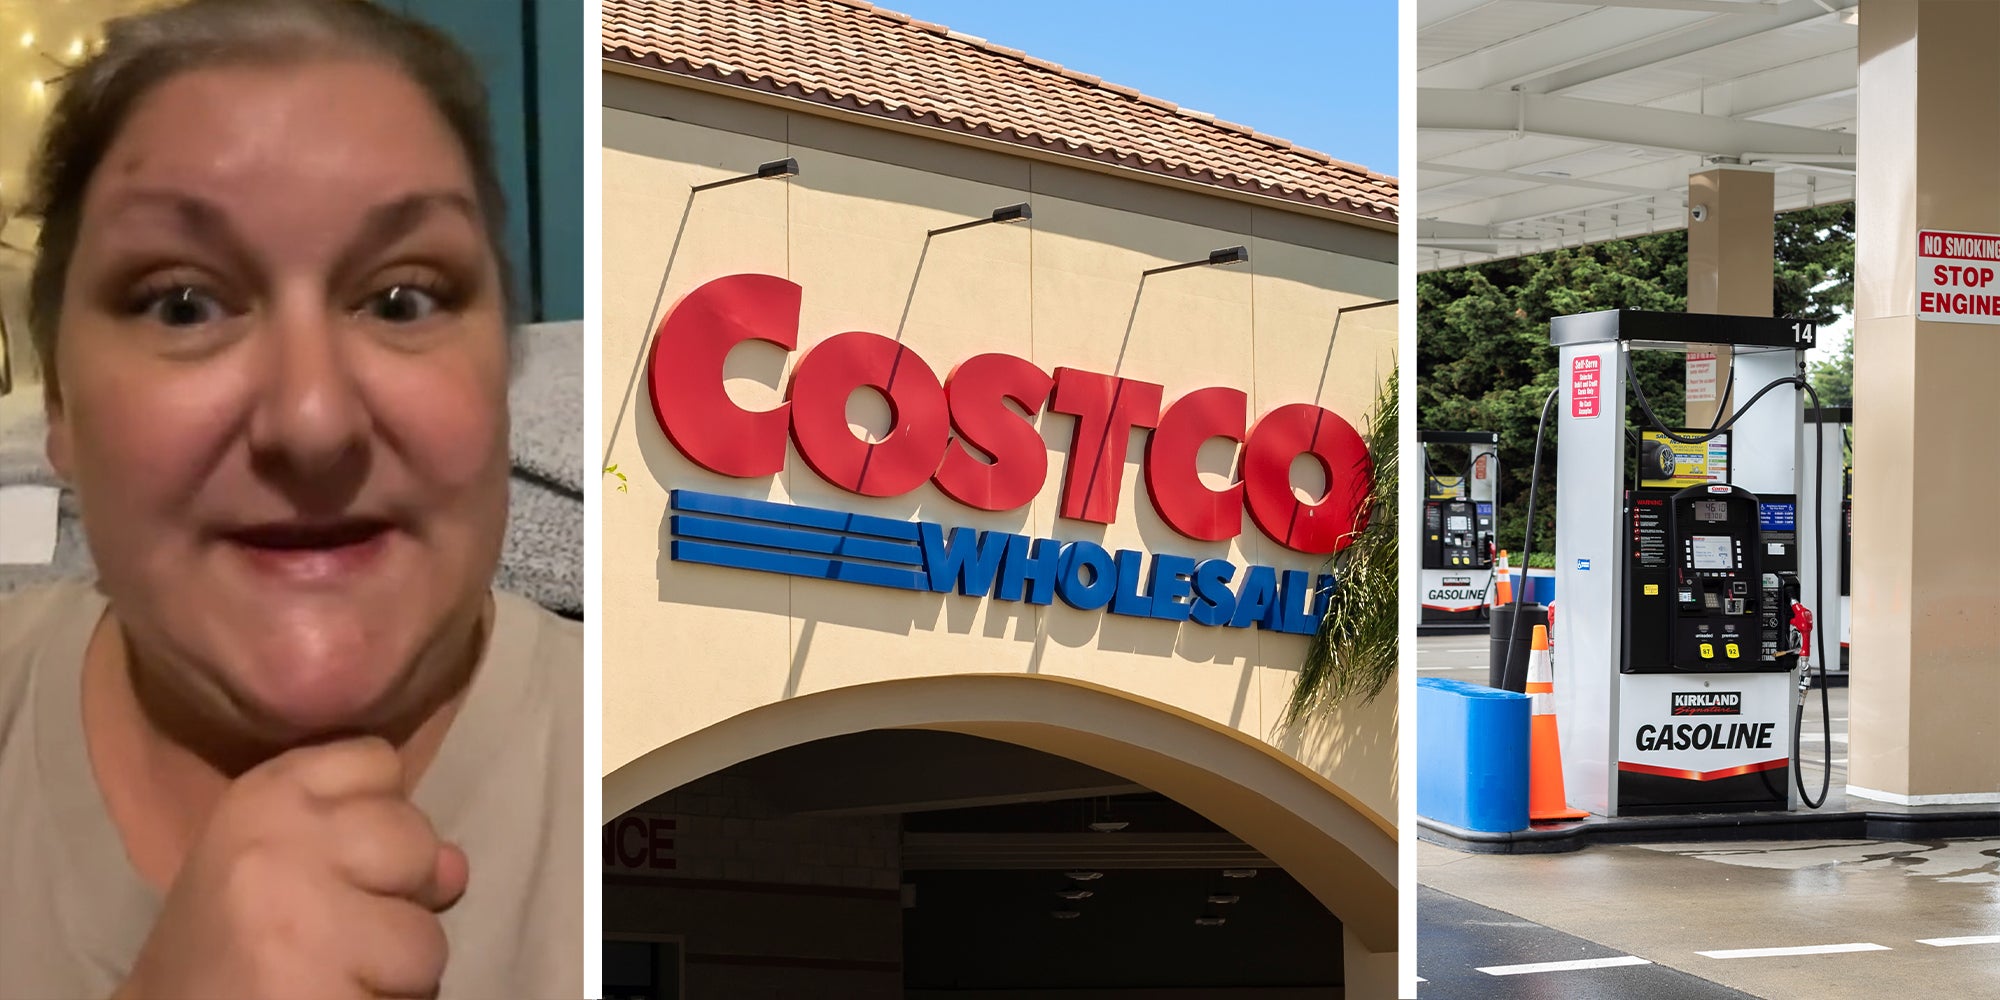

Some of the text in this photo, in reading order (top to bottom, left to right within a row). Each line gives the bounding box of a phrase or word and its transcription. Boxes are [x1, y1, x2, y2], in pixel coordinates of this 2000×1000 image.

[1924, 235, 1943, 256] NO
[1934, 264, 1994, 288] STOP
[1920, 291, 2000, 316] ENGINE
[1791, 322, 1813, 344] 14
[648, 273, 1375, 554] COSTCO
[1428, 589, 1486, 600] GASOLINE
[1674, 706, 1739, 716] Signature
[1675, 694, 1739, 706] KIRKLAND
[1636, 723, 1775, 751] GASOLINE
